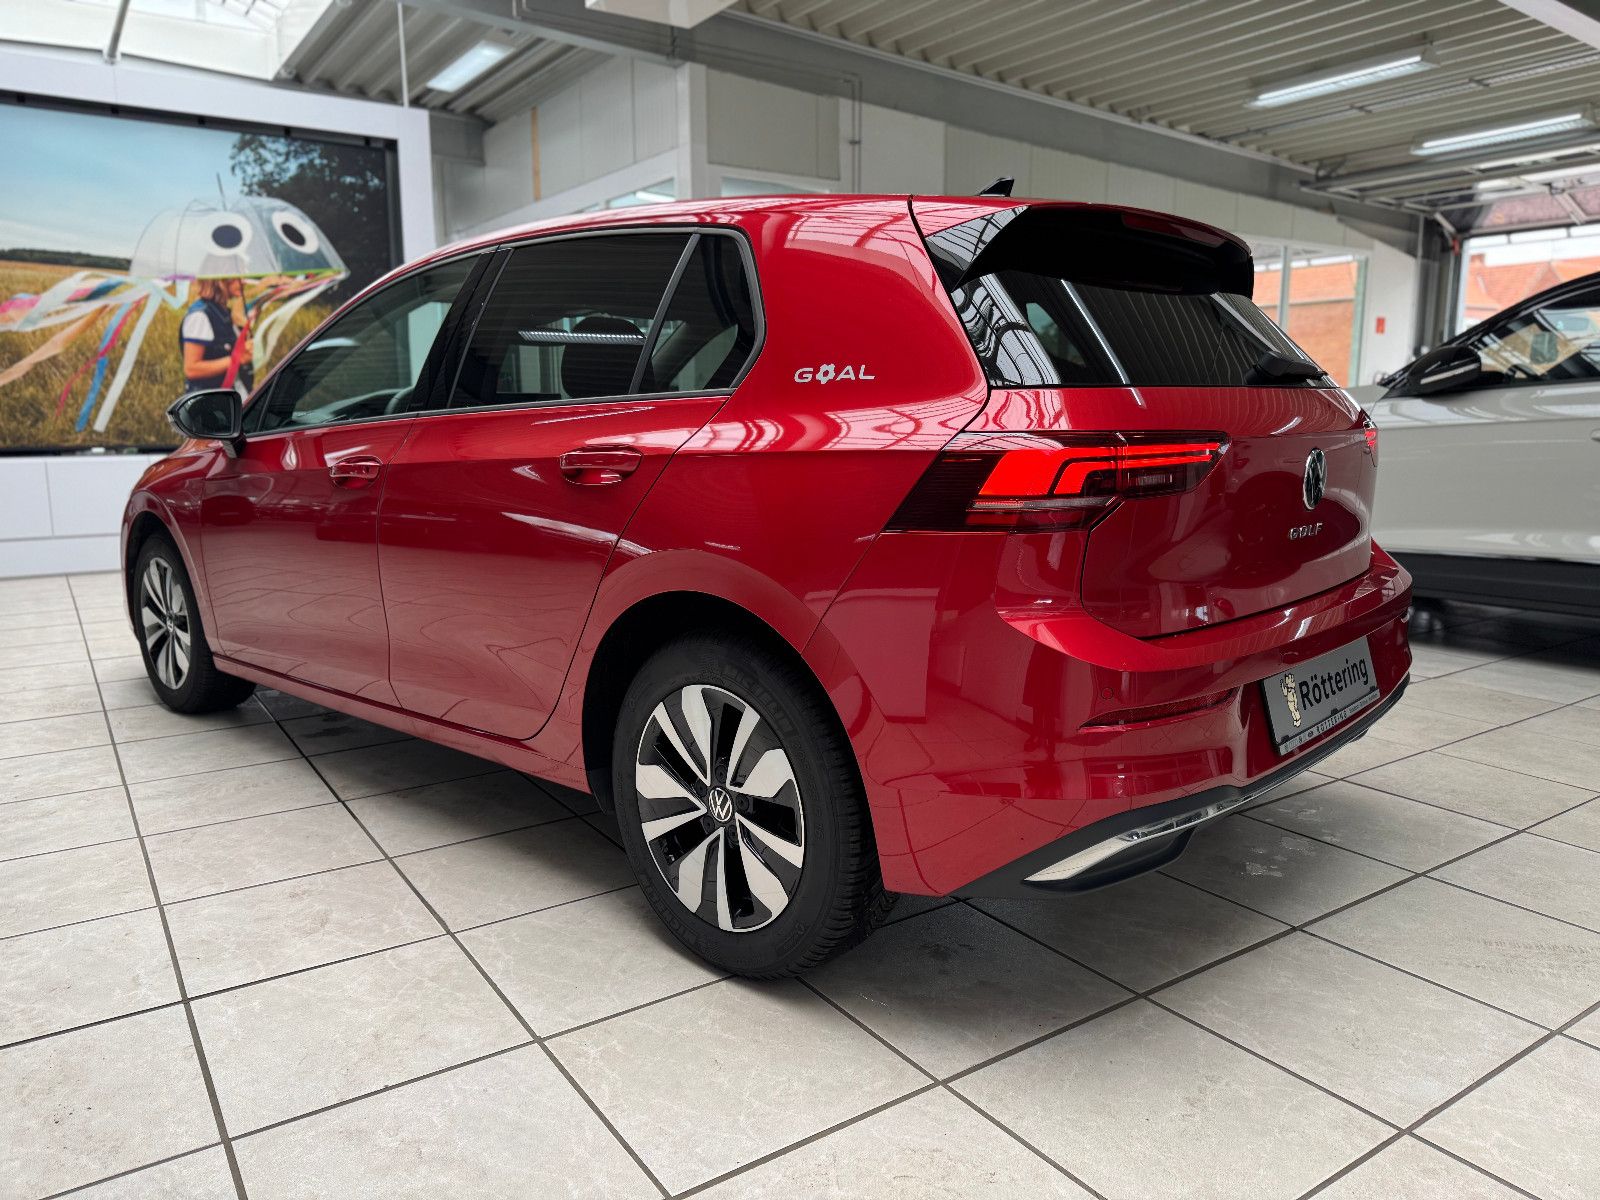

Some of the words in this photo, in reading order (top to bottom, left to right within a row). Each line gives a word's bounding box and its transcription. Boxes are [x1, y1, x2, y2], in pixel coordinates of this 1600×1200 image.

[794, 363, 876, 385] GOAL
[1289, 522, 1323, 540] GOLF
[1298, 658, 1369, 711] Röttering
